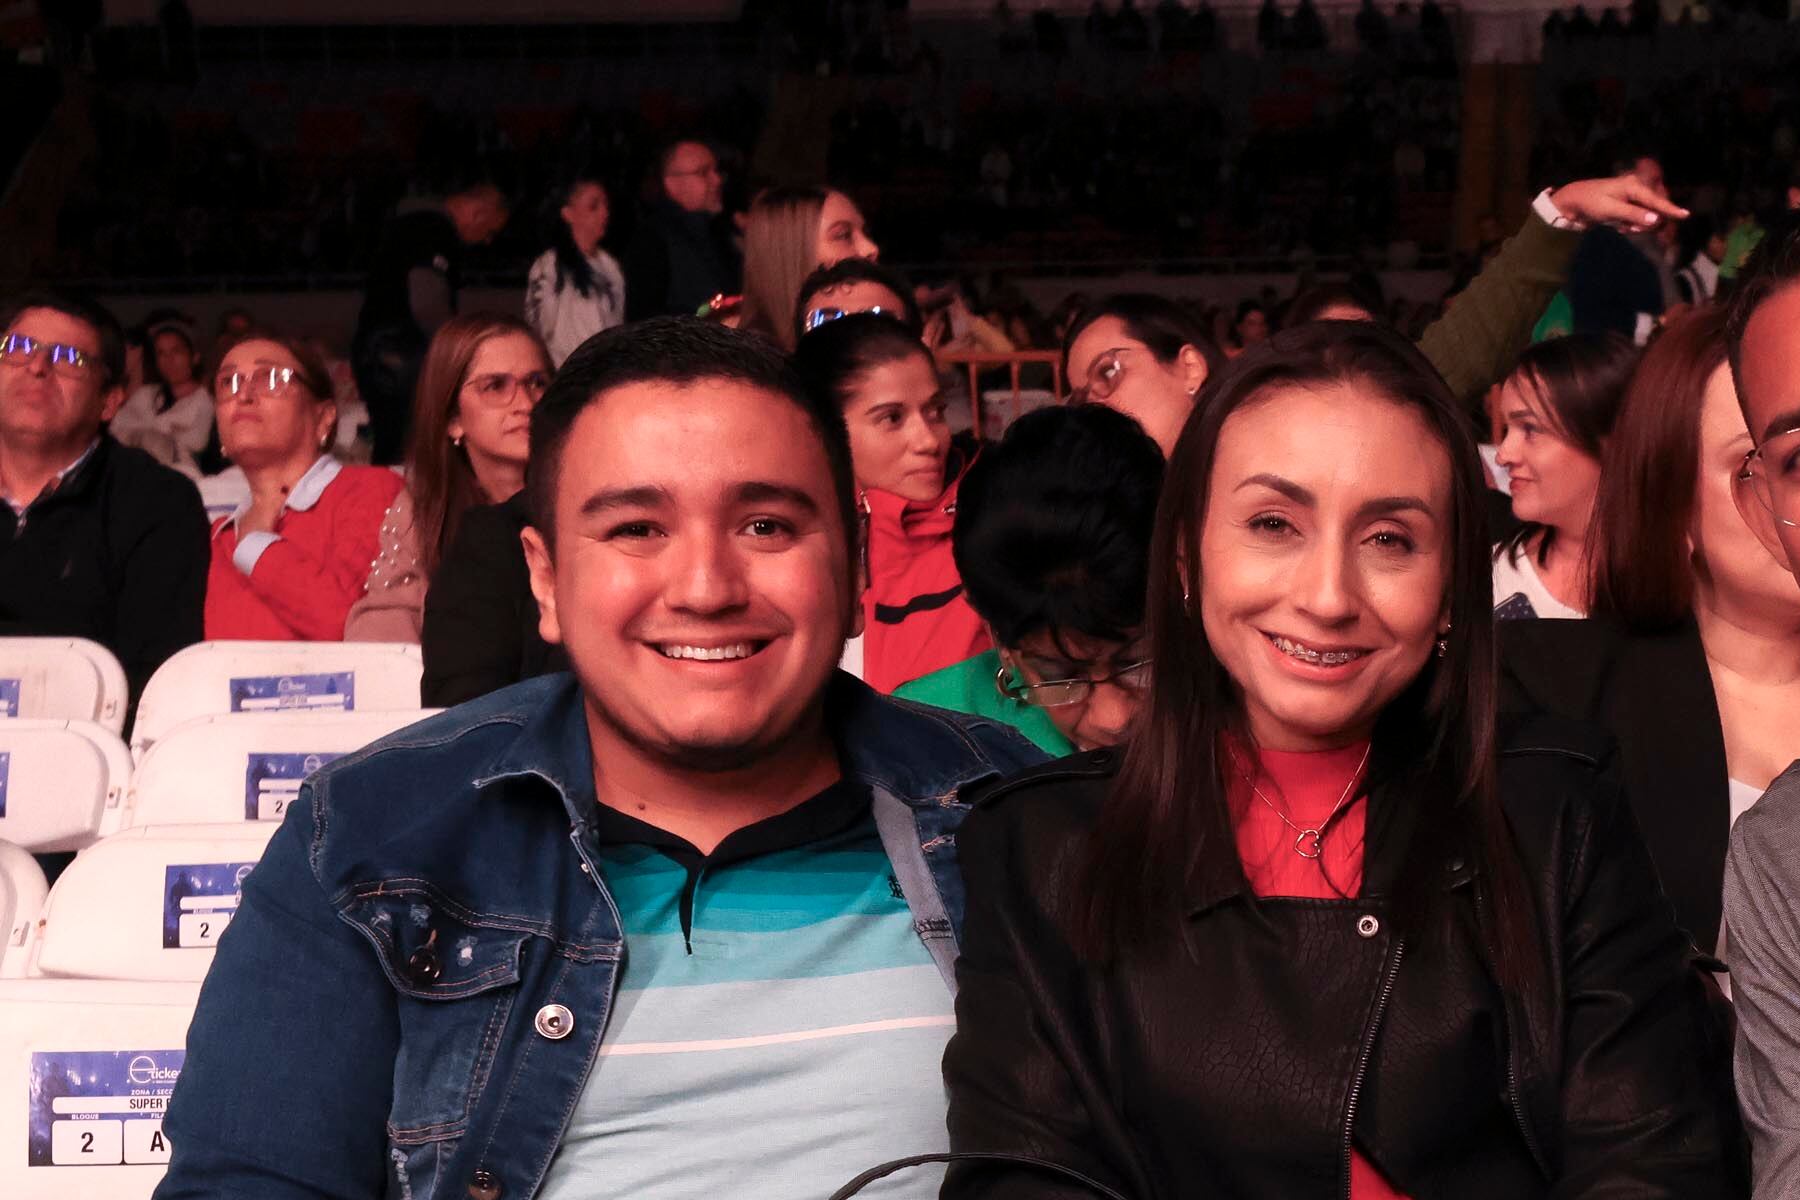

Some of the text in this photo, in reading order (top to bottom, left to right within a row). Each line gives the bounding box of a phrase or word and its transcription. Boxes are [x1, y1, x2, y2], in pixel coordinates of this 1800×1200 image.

[200, 922, 210, 939] 2
[130, 1098, 163, 1109] SUPER
[81, 1131, 95, 1153] 2
[150, 1130, 165, 1152] A
